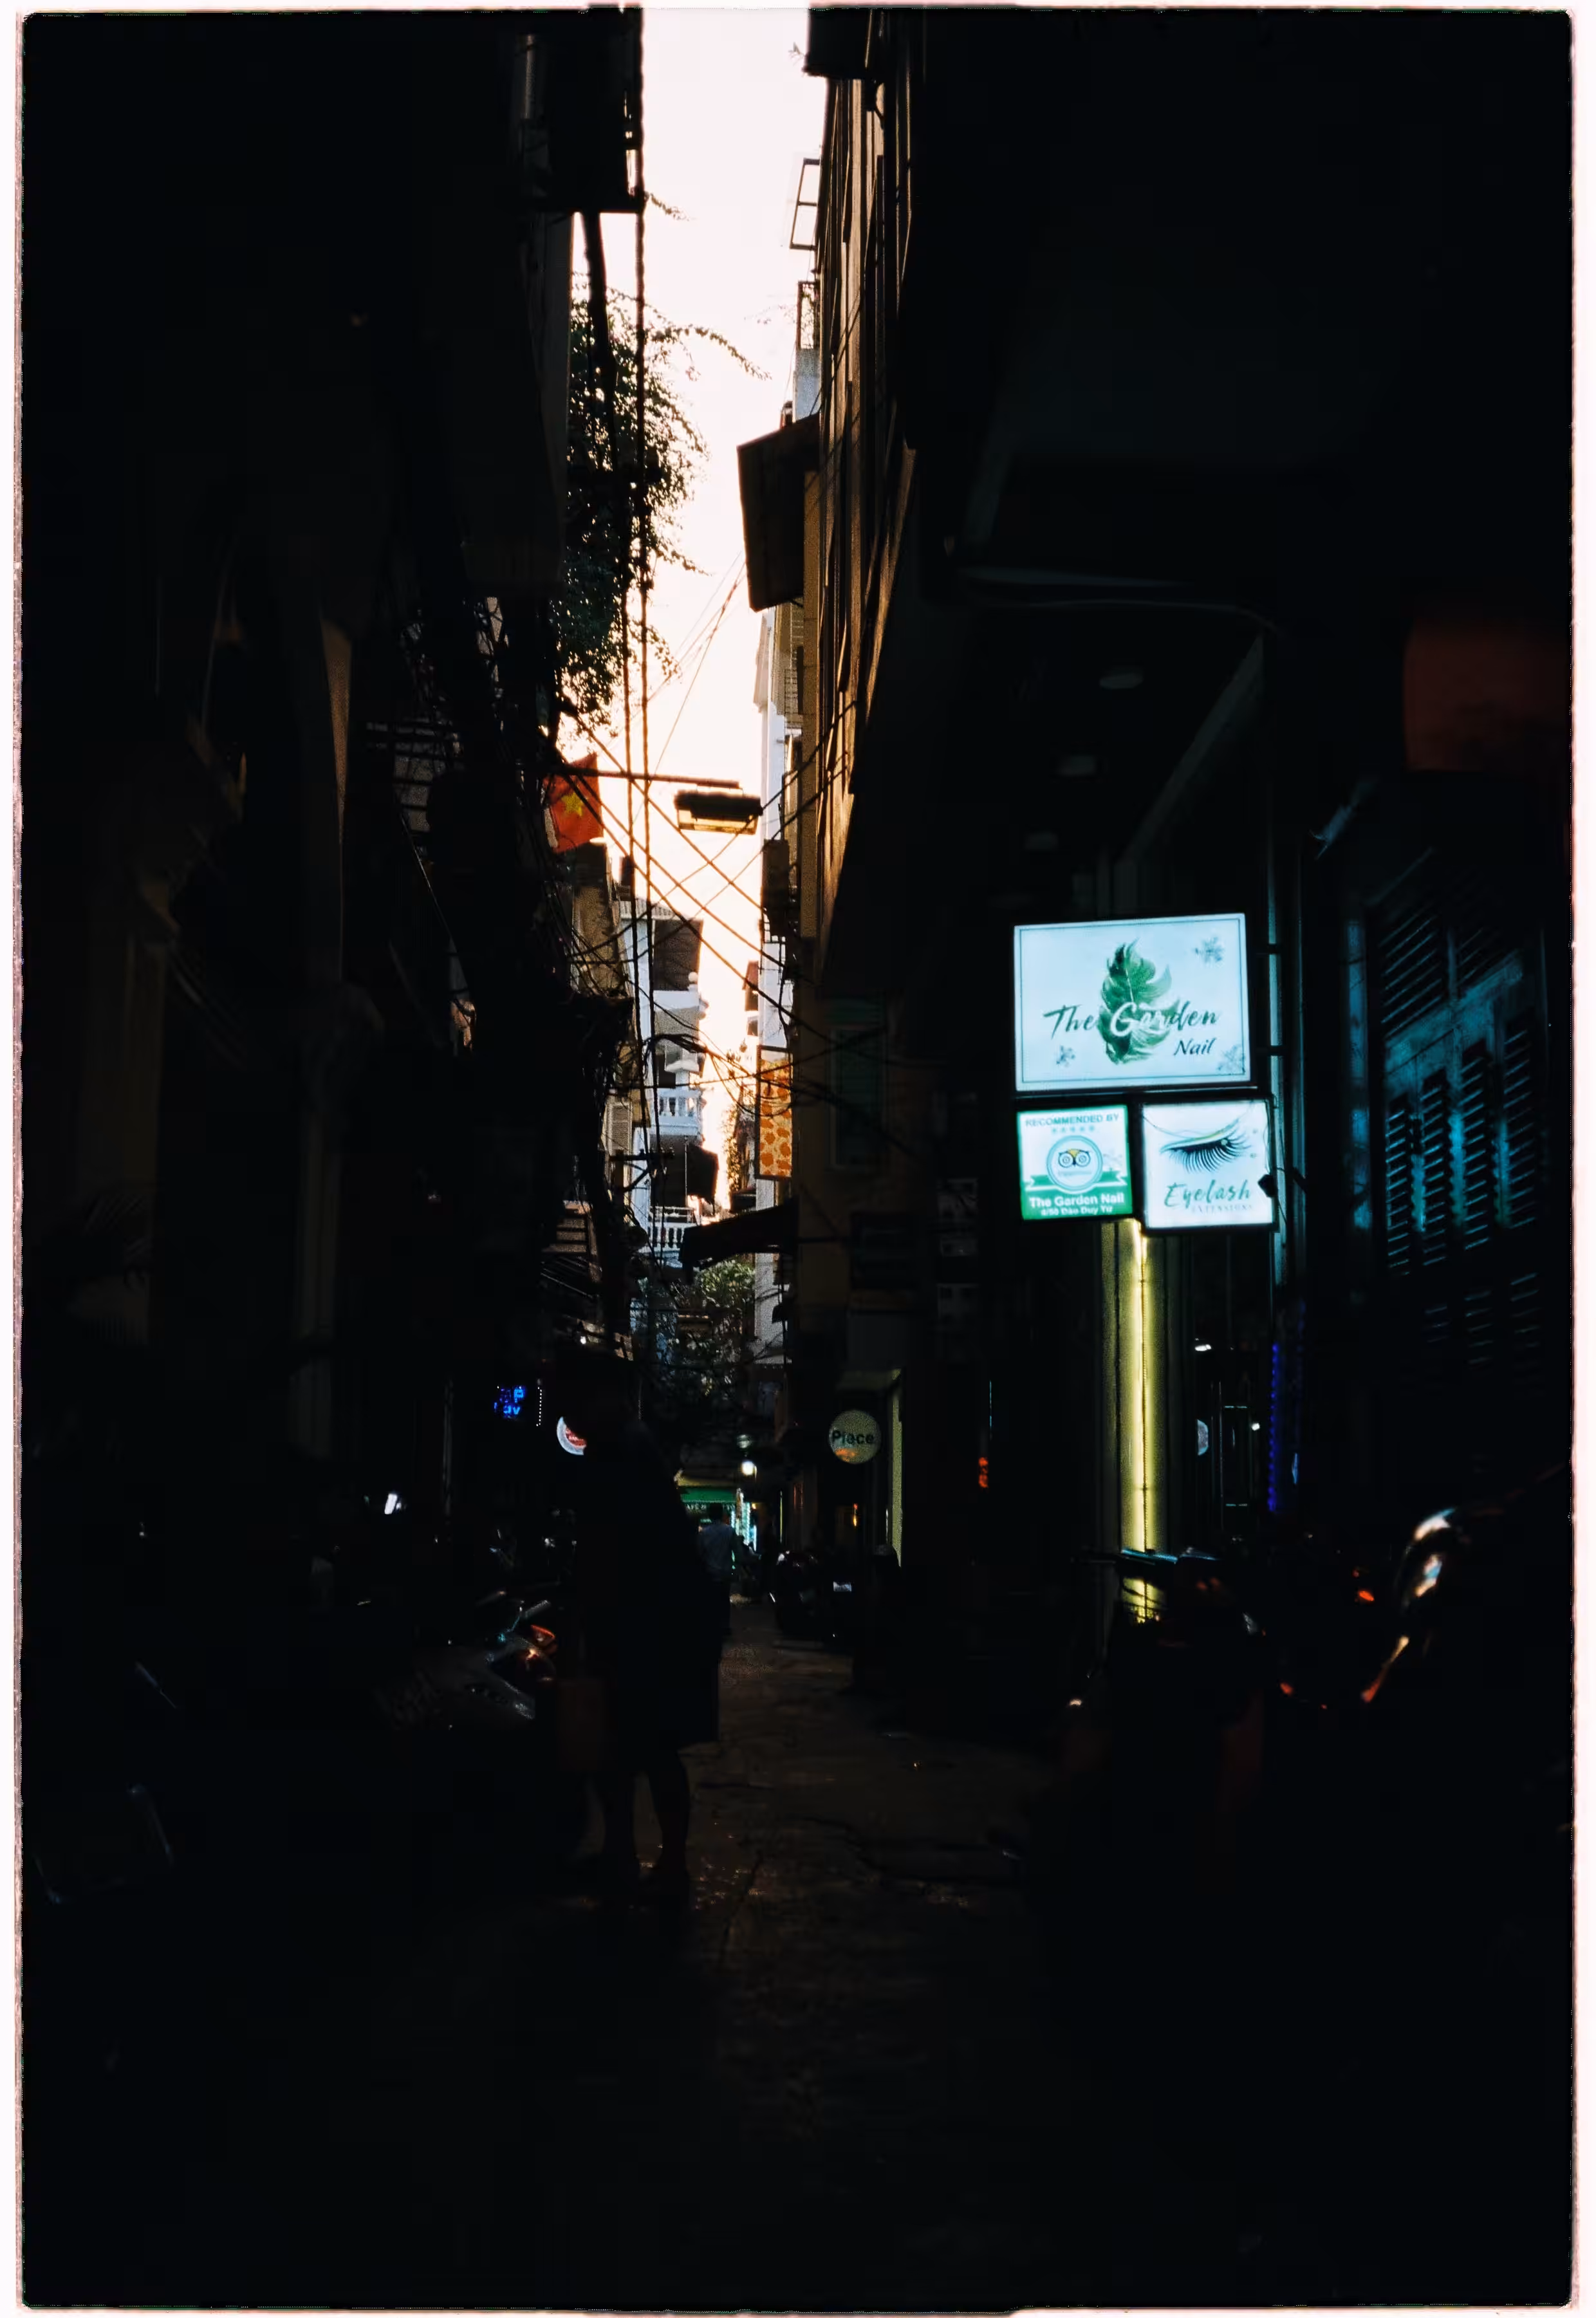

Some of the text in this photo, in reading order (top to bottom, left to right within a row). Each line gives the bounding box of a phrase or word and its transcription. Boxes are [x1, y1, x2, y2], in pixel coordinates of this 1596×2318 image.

[1043, 999, 1218, 1039] The Garden
[1173, 1037, 1216, 1056] Nail
[1025, 1113, 1119, 1126] RECOMMENDED BY
[1030, 1192, 1124, 1208] The Garden Nail
[1164, 1179, 1250, 1209] Eyelash
[832, 1430, 874, 1445] Place
